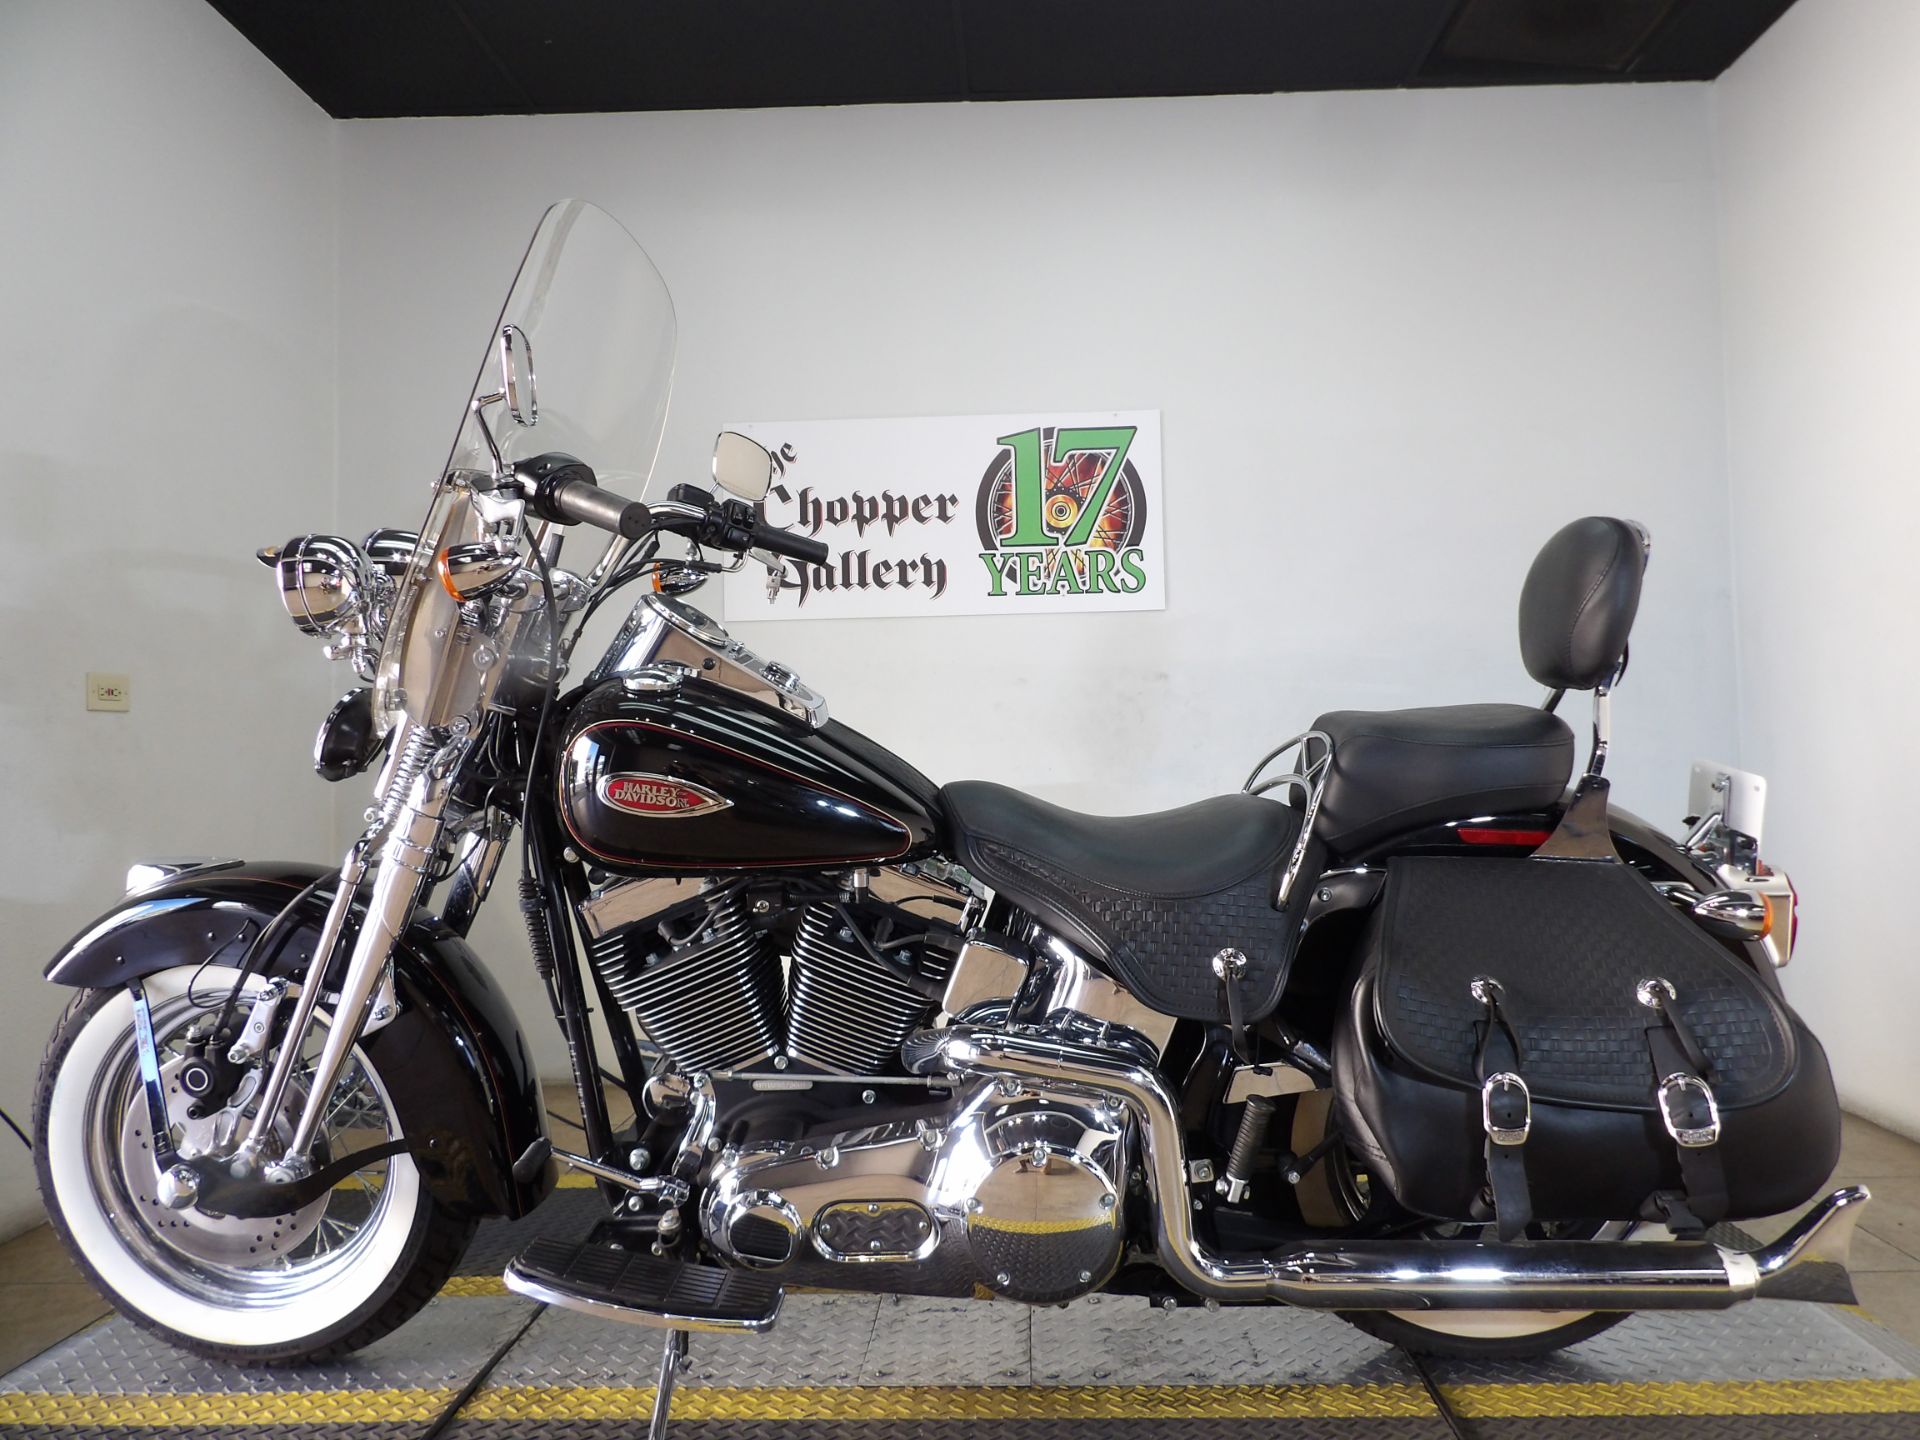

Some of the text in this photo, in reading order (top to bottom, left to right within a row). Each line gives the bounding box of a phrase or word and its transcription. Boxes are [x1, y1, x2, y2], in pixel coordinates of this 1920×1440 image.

[754, 484, 959, 538] Chopper
[997, 426, 1138, 547] 17
[979, 548, 1147, 596] YEARS
